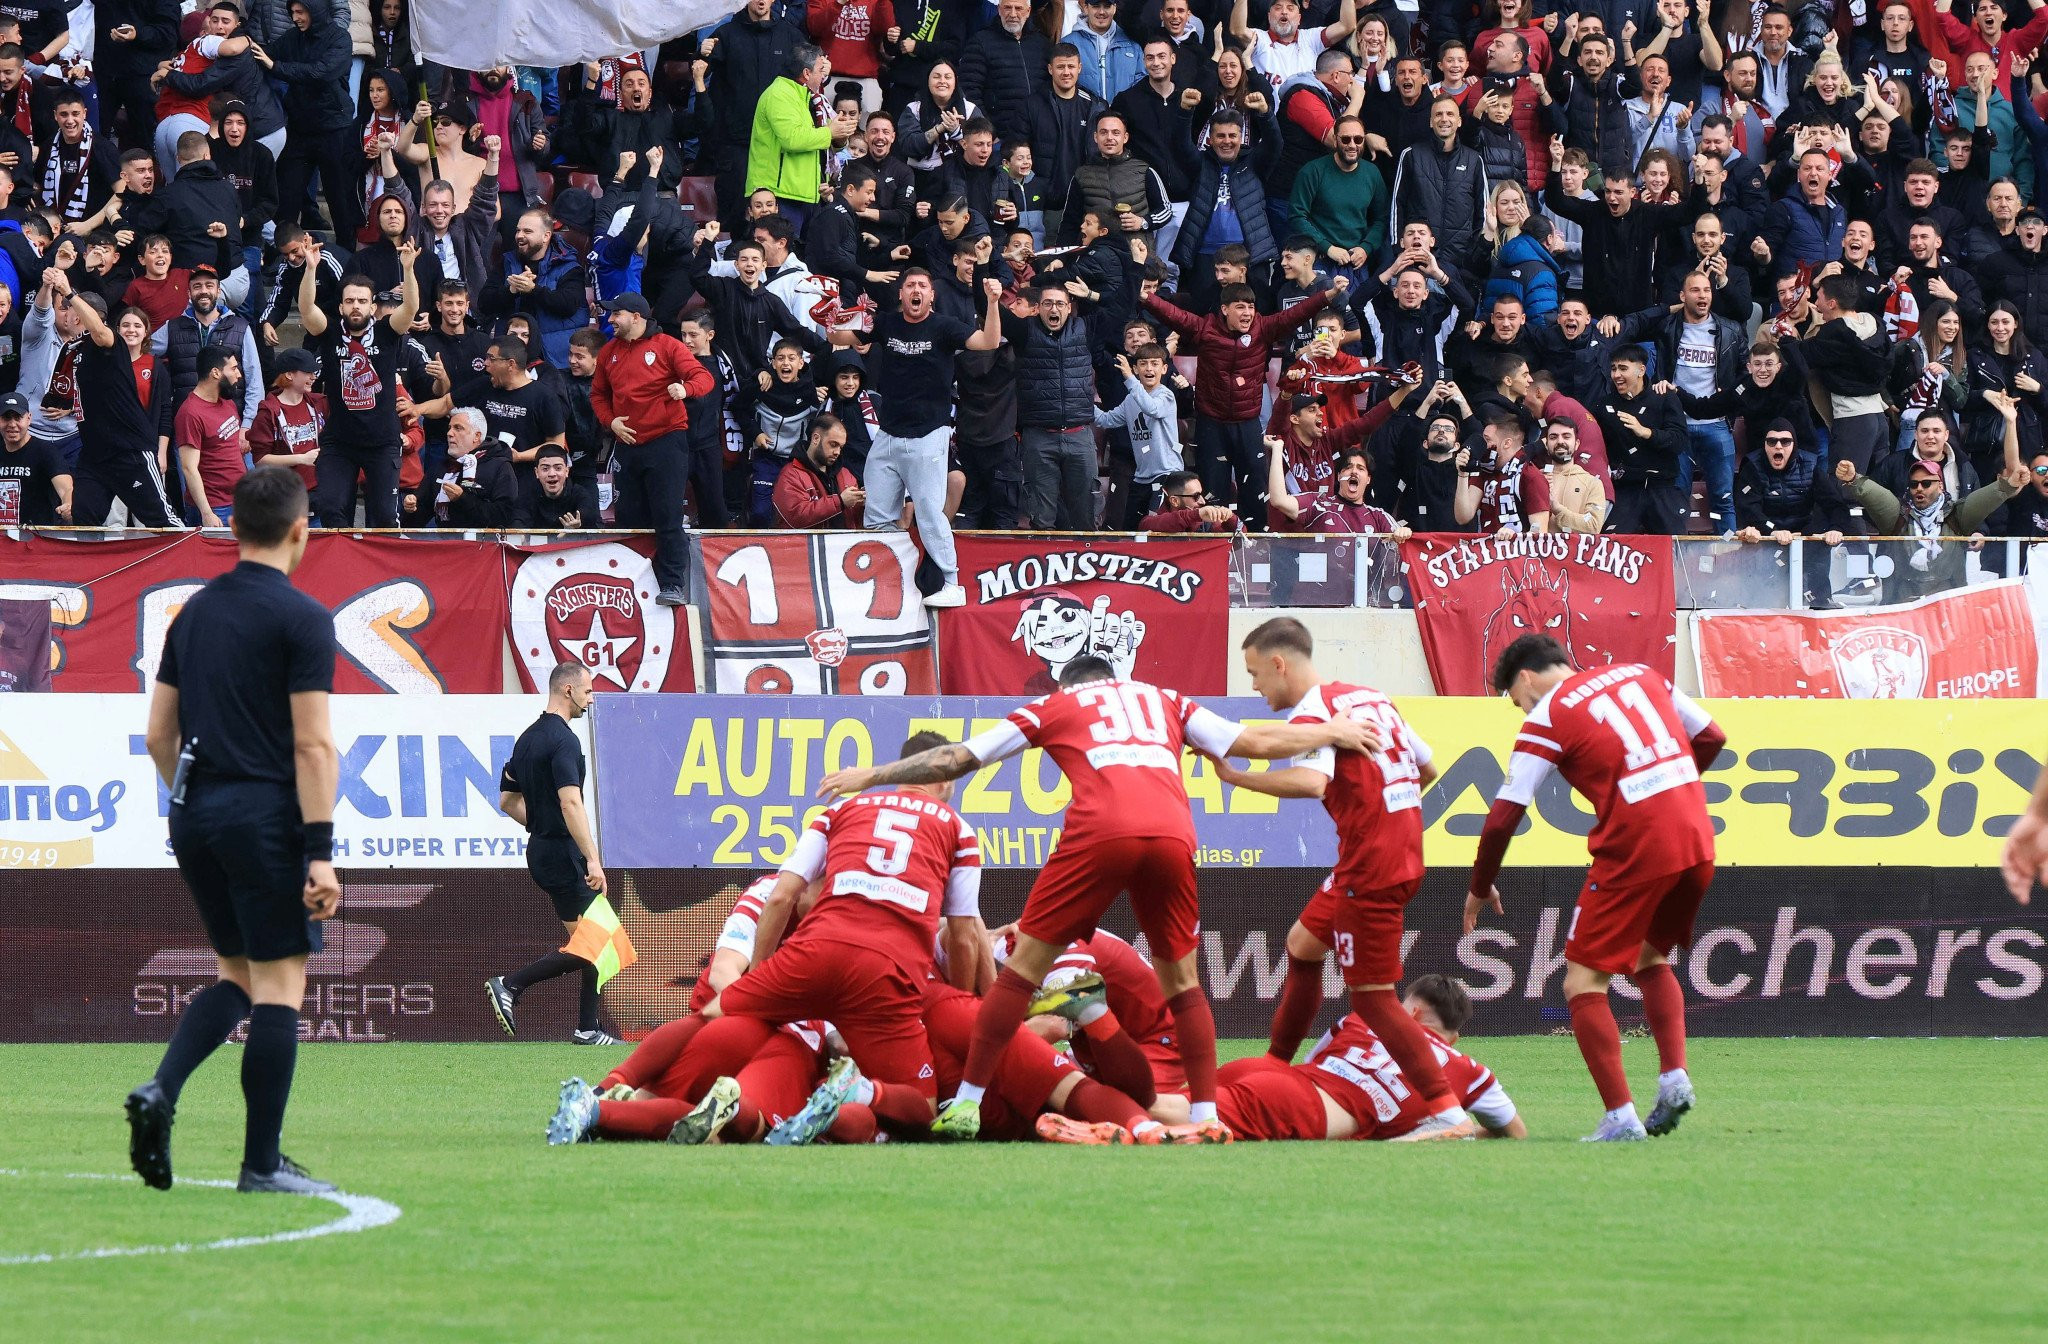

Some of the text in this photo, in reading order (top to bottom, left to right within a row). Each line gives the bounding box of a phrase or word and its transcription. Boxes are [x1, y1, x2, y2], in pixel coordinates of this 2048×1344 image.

[842, 540, 904, 620] 9
[977, 551, 1201, 603] MONSTERS
[1427, 532, 1645, 588] STATHMOS FANS
[548, 583, 634, 622] MONSTERS
[582, 641, 615, 667] G1
[1937, 666, 2021, 699] EUROPE
[1076, 682, 1169, 745] 30
[1588, 680, 1682, 771] 11
[674, 718, 873, 797] AUTO
[362, 838, 445, 857] SUPER
[710, 804, 831, 865] 25
[866, 808, 920, 876] 5
[839, 877, 925, 904] AegeanCollege
[133, 984, 435, 1015] SKHERS
